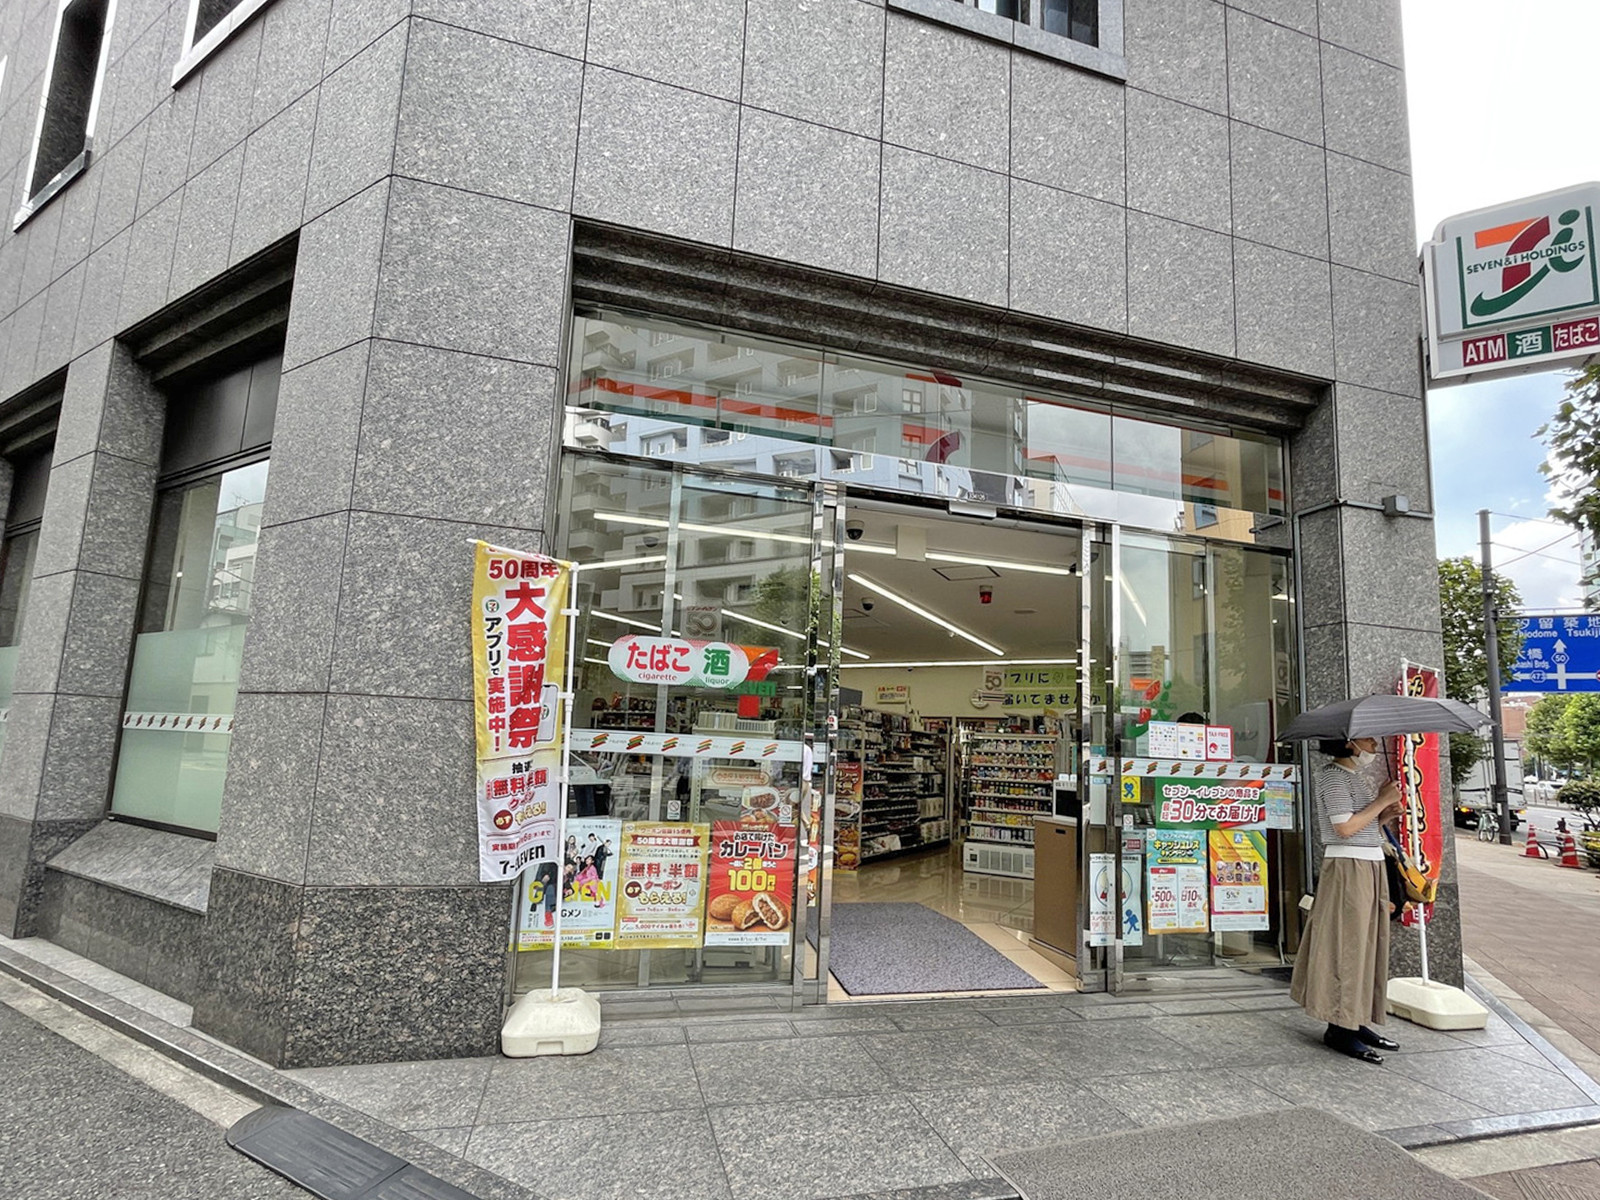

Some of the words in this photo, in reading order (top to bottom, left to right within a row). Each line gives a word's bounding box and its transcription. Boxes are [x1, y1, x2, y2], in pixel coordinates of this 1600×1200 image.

[1521, 241, 1586, 263] HOLDINGS
[1516, 331, 1542, 355] 酒
[1555, 322, 1599, 349] たばこ
[1465, 337, 1504, 363] ATM
[489, 559, 560, 579] 50周年
[505, 582, 548, 749] 大感謝祭
[626, 641, 691, 673] たばこ
[703, 648, 731, 676] 酒
[1554, 654, 1566, 662] 50
[638, 672, 678, 681] cigarette
[705, 676, 729, 685] liquor
[720, 841, 788, 858] カレーパン
[644, 880, 682, 891] クーポン
[728, 869, 776, 892] 100円
[639, 891, 687, 905] もらえる!
[561, 909, 582, 918] Gメン
